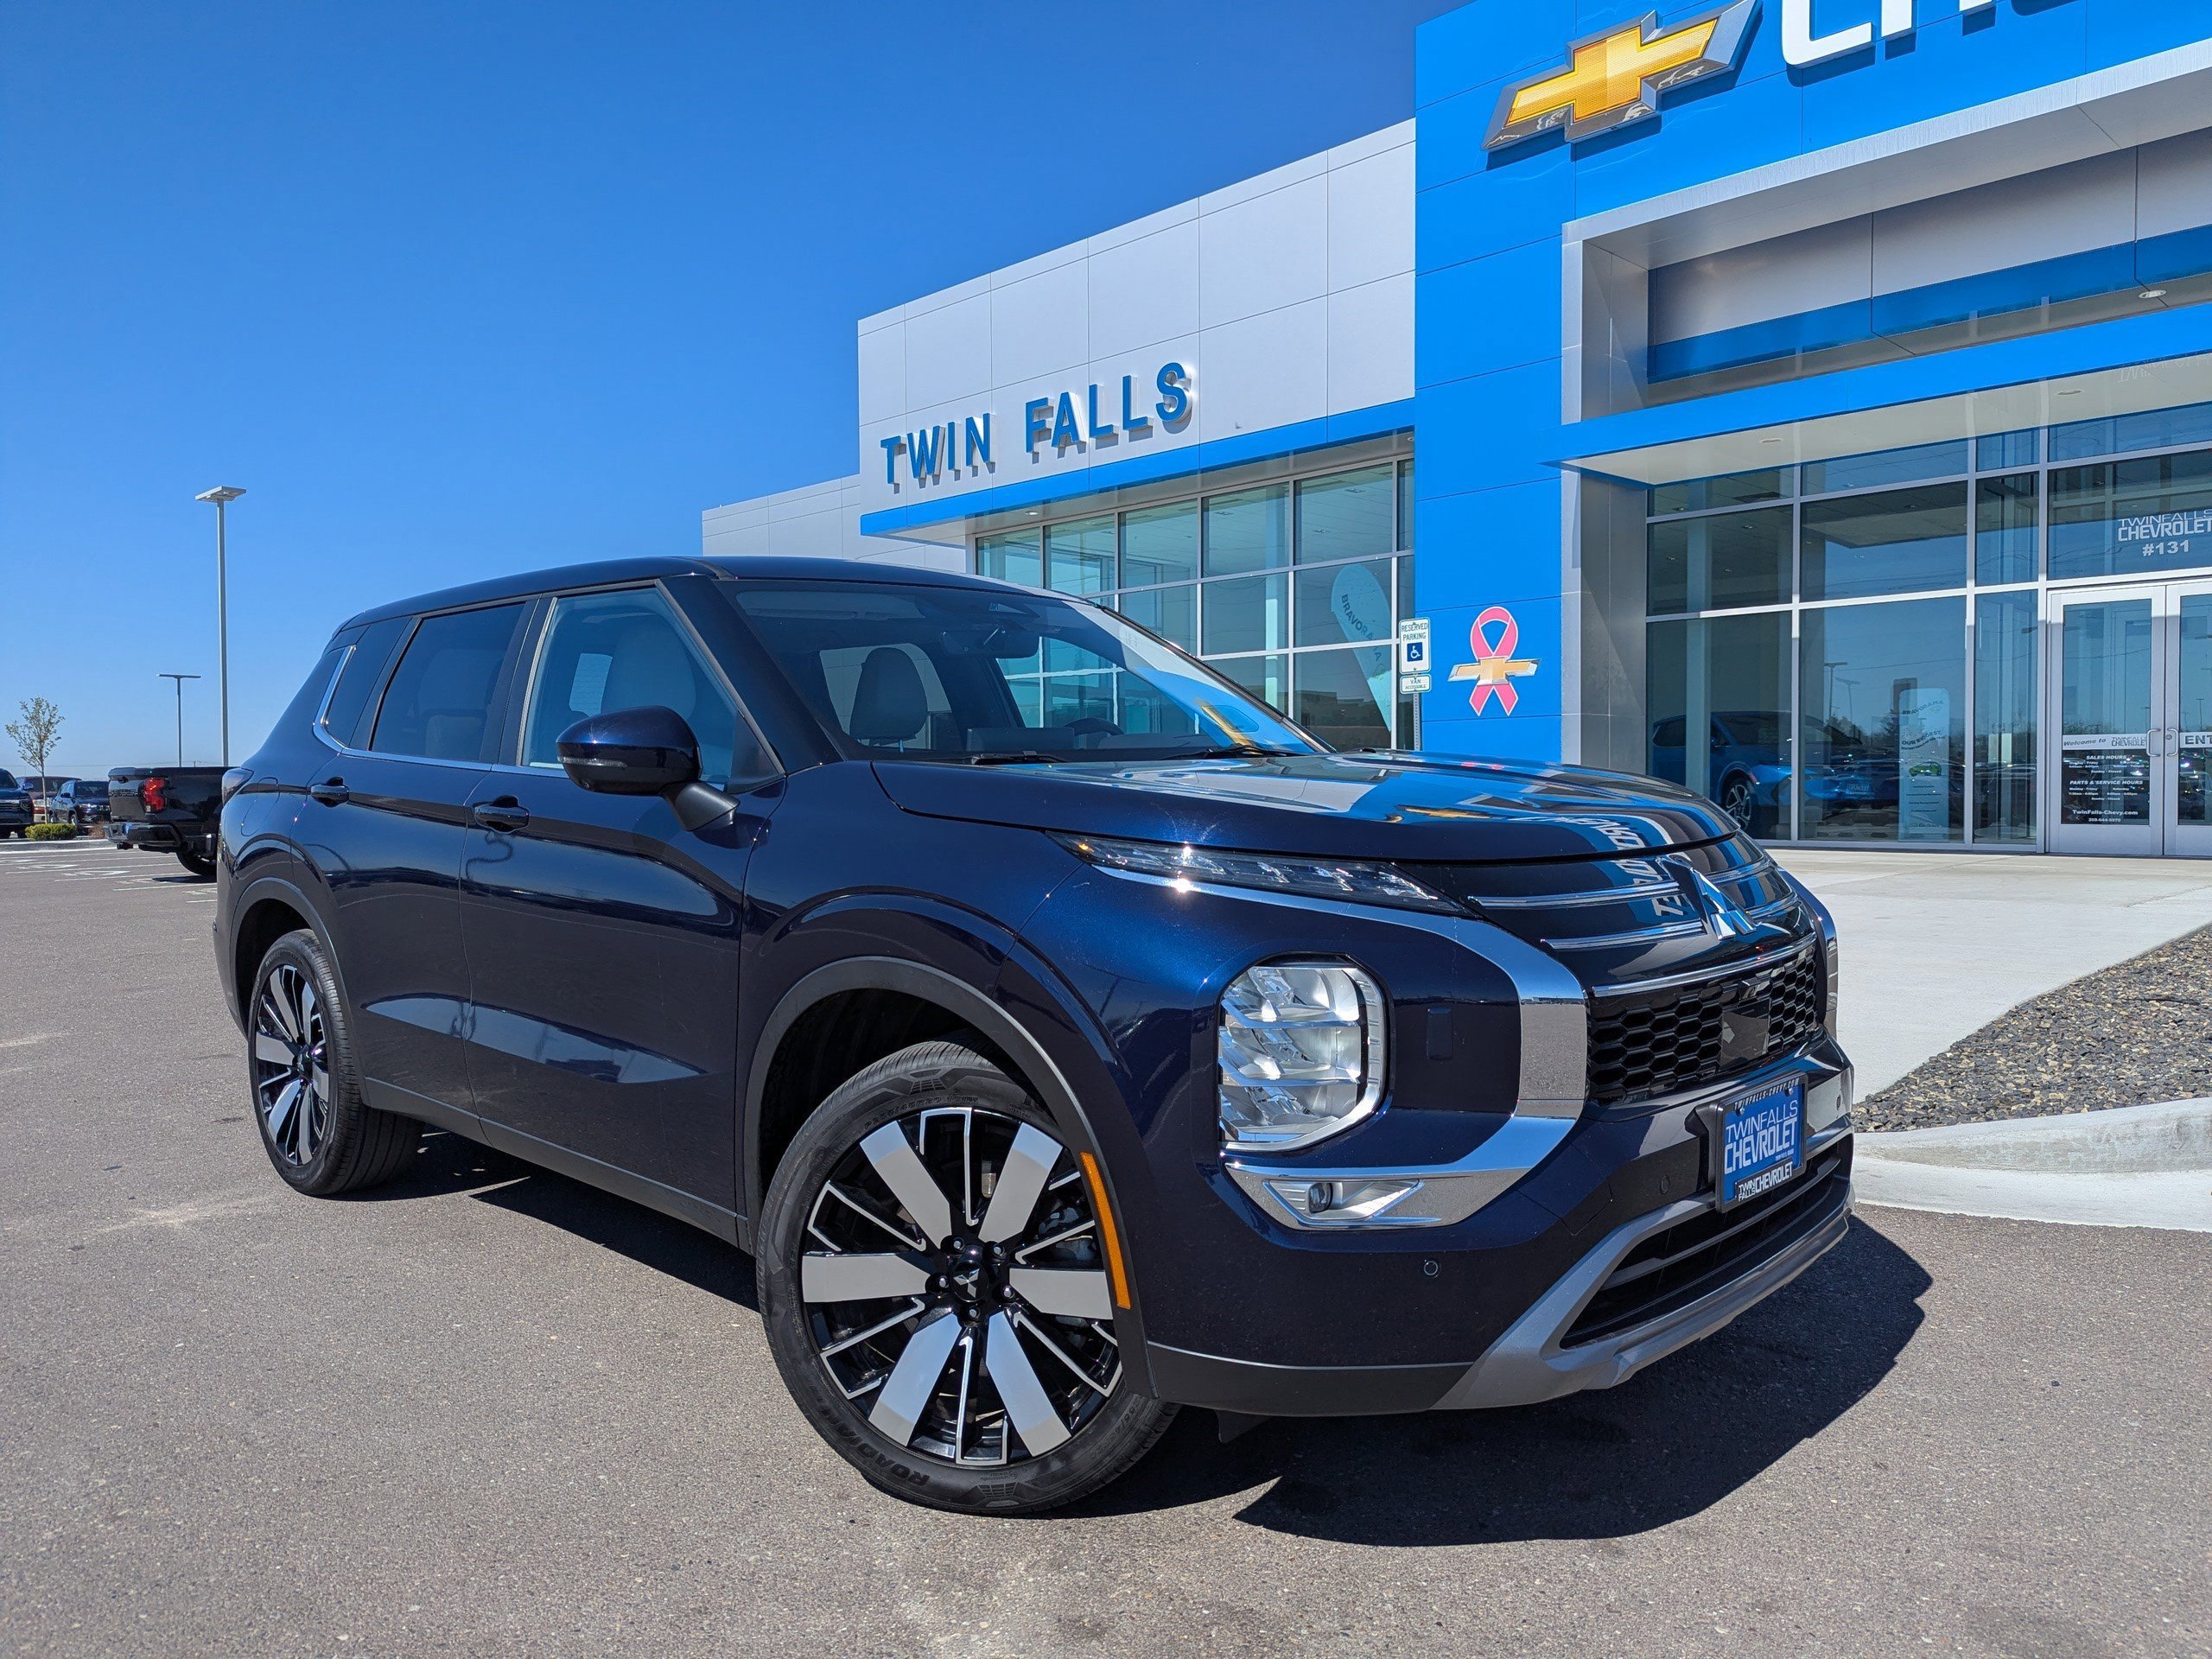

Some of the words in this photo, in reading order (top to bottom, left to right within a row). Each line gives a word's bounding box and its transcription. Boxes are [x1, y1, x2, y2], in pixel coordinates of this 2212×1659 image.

[880, 412, 995, 487] TWIN
[1024, 361, 1192, 455] FALLS
[2117, 509, 2212, 527] TWINFALLS
[2117, 518, 2212, 542] CHEVROLET
[2142, 539, 2190, 556] #131
[1341, 594, 1382, 662] BRAVORAA
[1401, 622, 1428, 632] RESERVED
[1402, 632, 1427, 642] PARKING
[1726, 1099, 1798, 1142] TWINFALLS
[1724, 1116, 1798, 1175] CHEVROLET
[1738, 1178, 1756, 1193] TWIN
[1755, 1160, 1793, 1192] CHEVROLET
[1738, 1188, 1756, 1202] FALLS
